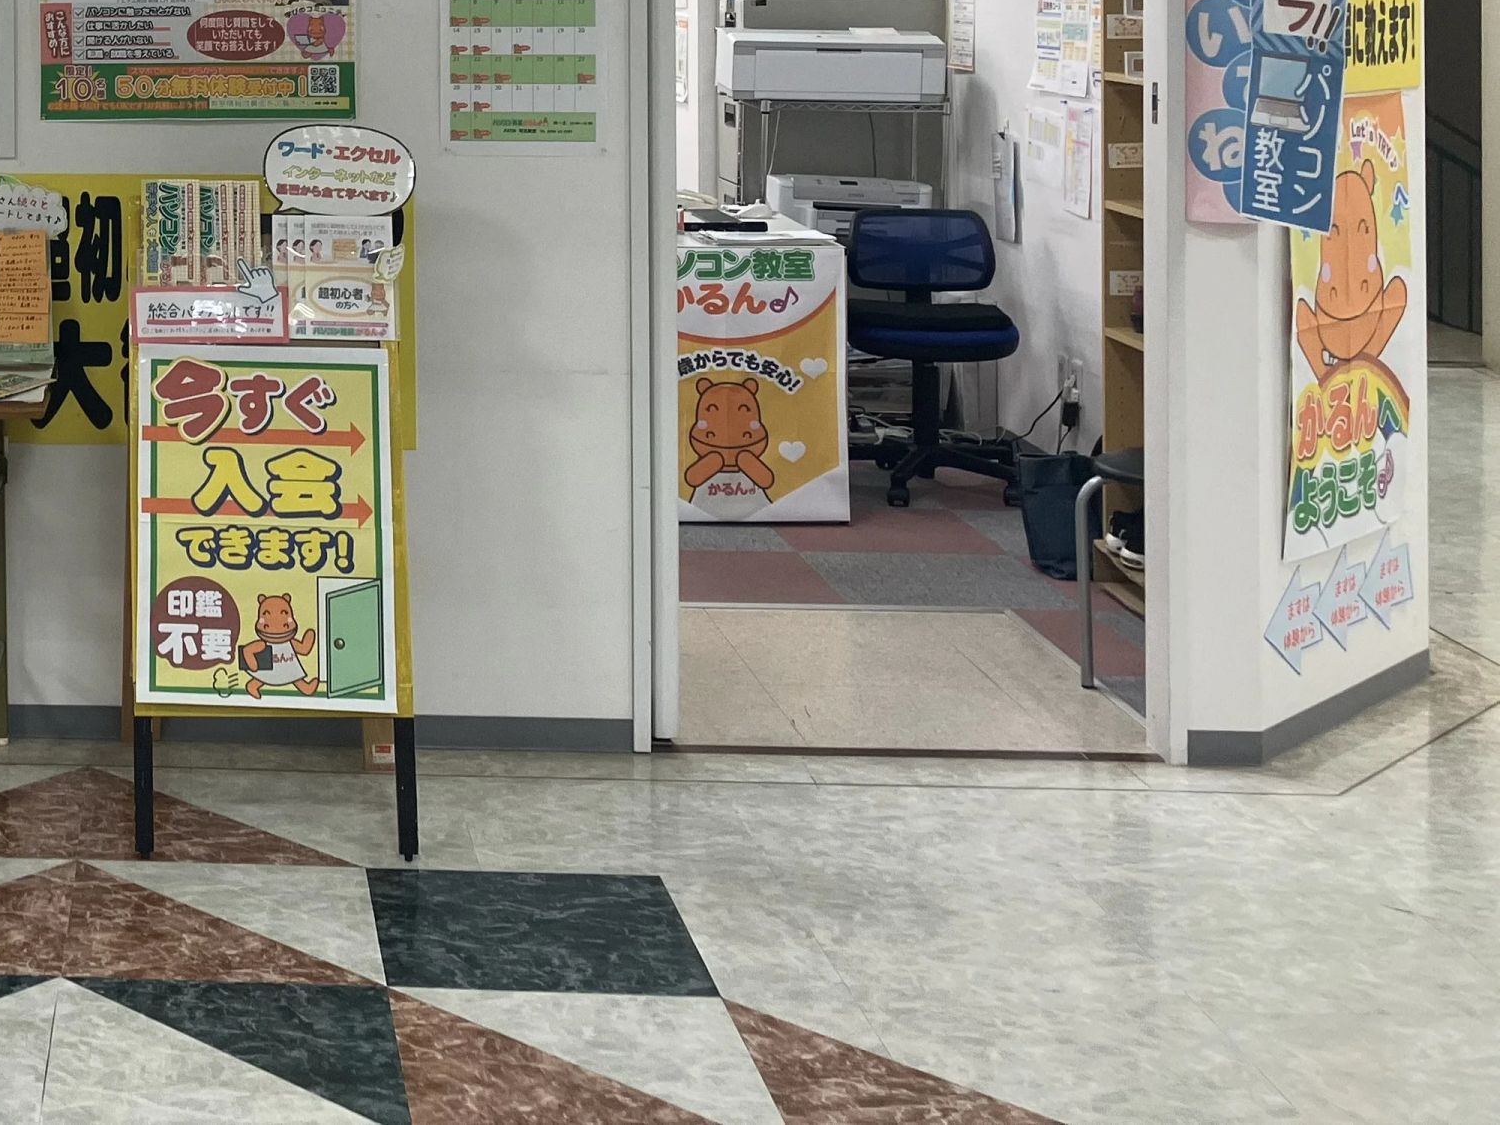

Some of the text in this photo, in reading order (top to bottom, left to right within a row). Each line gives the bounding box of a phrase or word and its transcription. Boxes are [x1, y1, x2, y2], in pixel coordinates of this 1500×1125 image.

[85, 6, 191, 17] パソコンに触ったことがない
[199, 17, 274, 28] 何度同じ質問をして
[85, 21, 154, 32] 仕事に活かしたい
[211, 29, 263, 40] いただいても
[1293, 64, 1332, 215] パソコン
[277, 141, 401, 164] ワード・エクセル
[282, 164, 397, 186] インターネットなど
[1252, 127, 1287, 213] 教室
[317, 286, 364, 301] 超初心者
[335, 301, 360, 310] の方へ
[153, 356, 336, 444] 今すぐ
[191, 447, 342, 519] 入会
[1293, 449, 1378, 535] ようこそ
[1335, 573, 1357, 598] まずは
[167, 589, 223, 618] 印鑑
[1287, 594, 1311, 621] まずは
[157, 622, 232, 665] 不要
